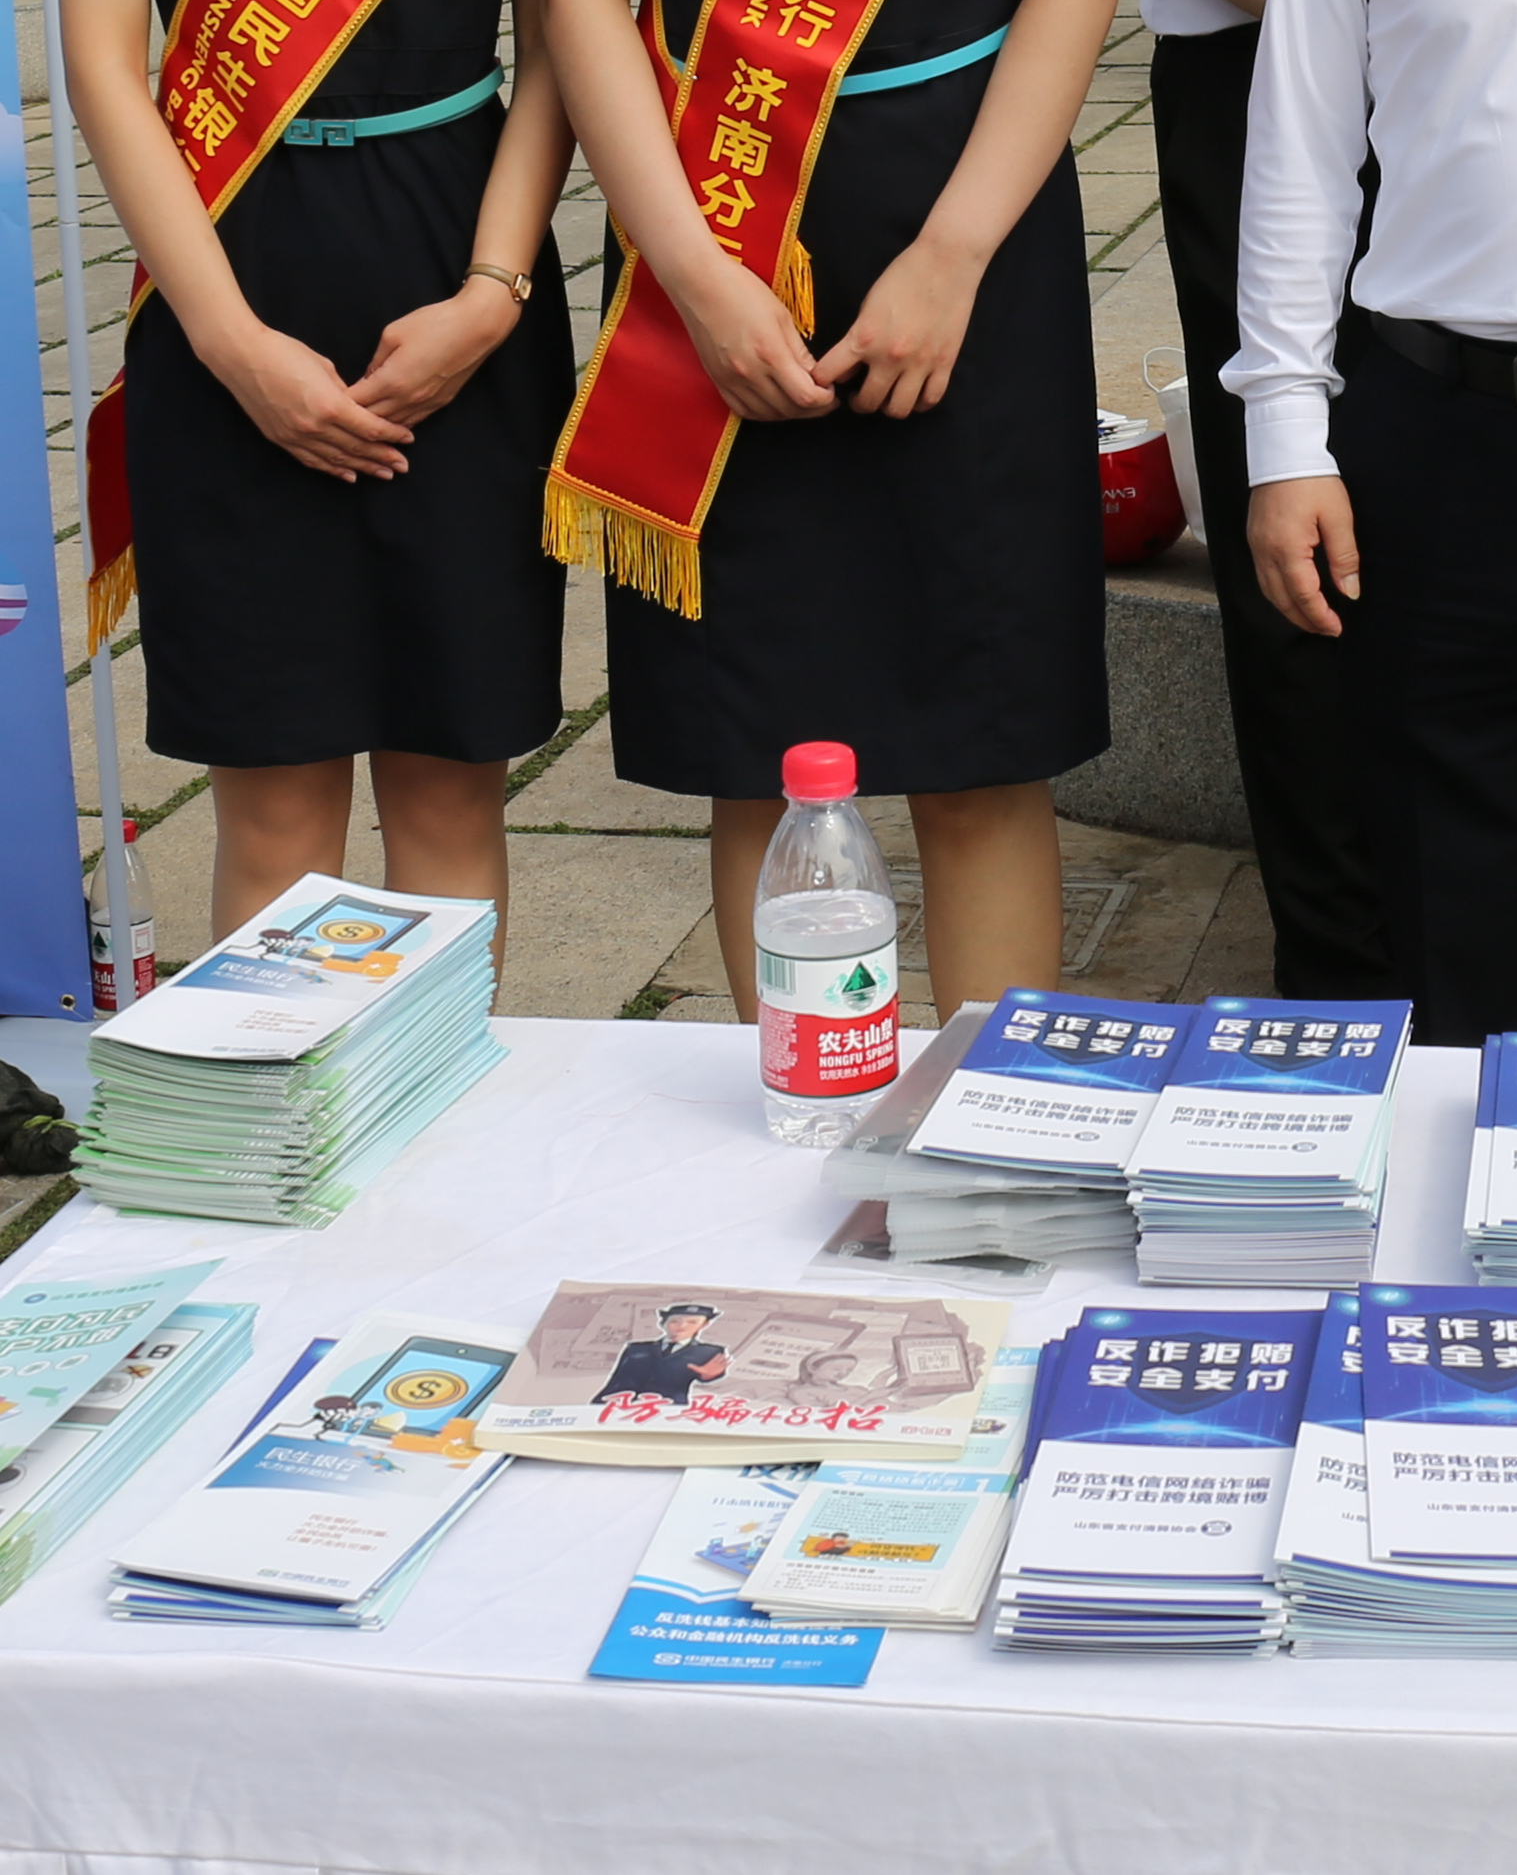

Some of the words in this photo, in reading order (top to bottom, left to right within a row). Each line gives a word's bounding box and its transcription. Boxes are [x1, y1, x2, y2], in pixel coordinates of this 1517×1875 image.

[218, 961, 299, 983] 民生银行
[817, 1017, 894, 1054] 农夫山泉
[1010, 1008, 1177, 1042] 反诈拒赌
[1213, 1017, 1384, 1040] 反诈拒赌
[1001, 1024, 1168, 1058] 安全支付
[1206, 1035, 1378, 1058] 安全支付
[819, 1052, 864, 1068] NONGFU
[1095, 1338, 1294, 1365] 反诈拒赌
[1087, 1364, 1290, 1392] 安全支付
[597, 1389, 888, 1431] 防骗48招
[264, 1446, 363, 1472] 民生银行
[1056, 1470, 1272, 1490] 防范电信网络诈骗
[1051, 1485, 1270, 1505] 严厉打击跨境赌博
